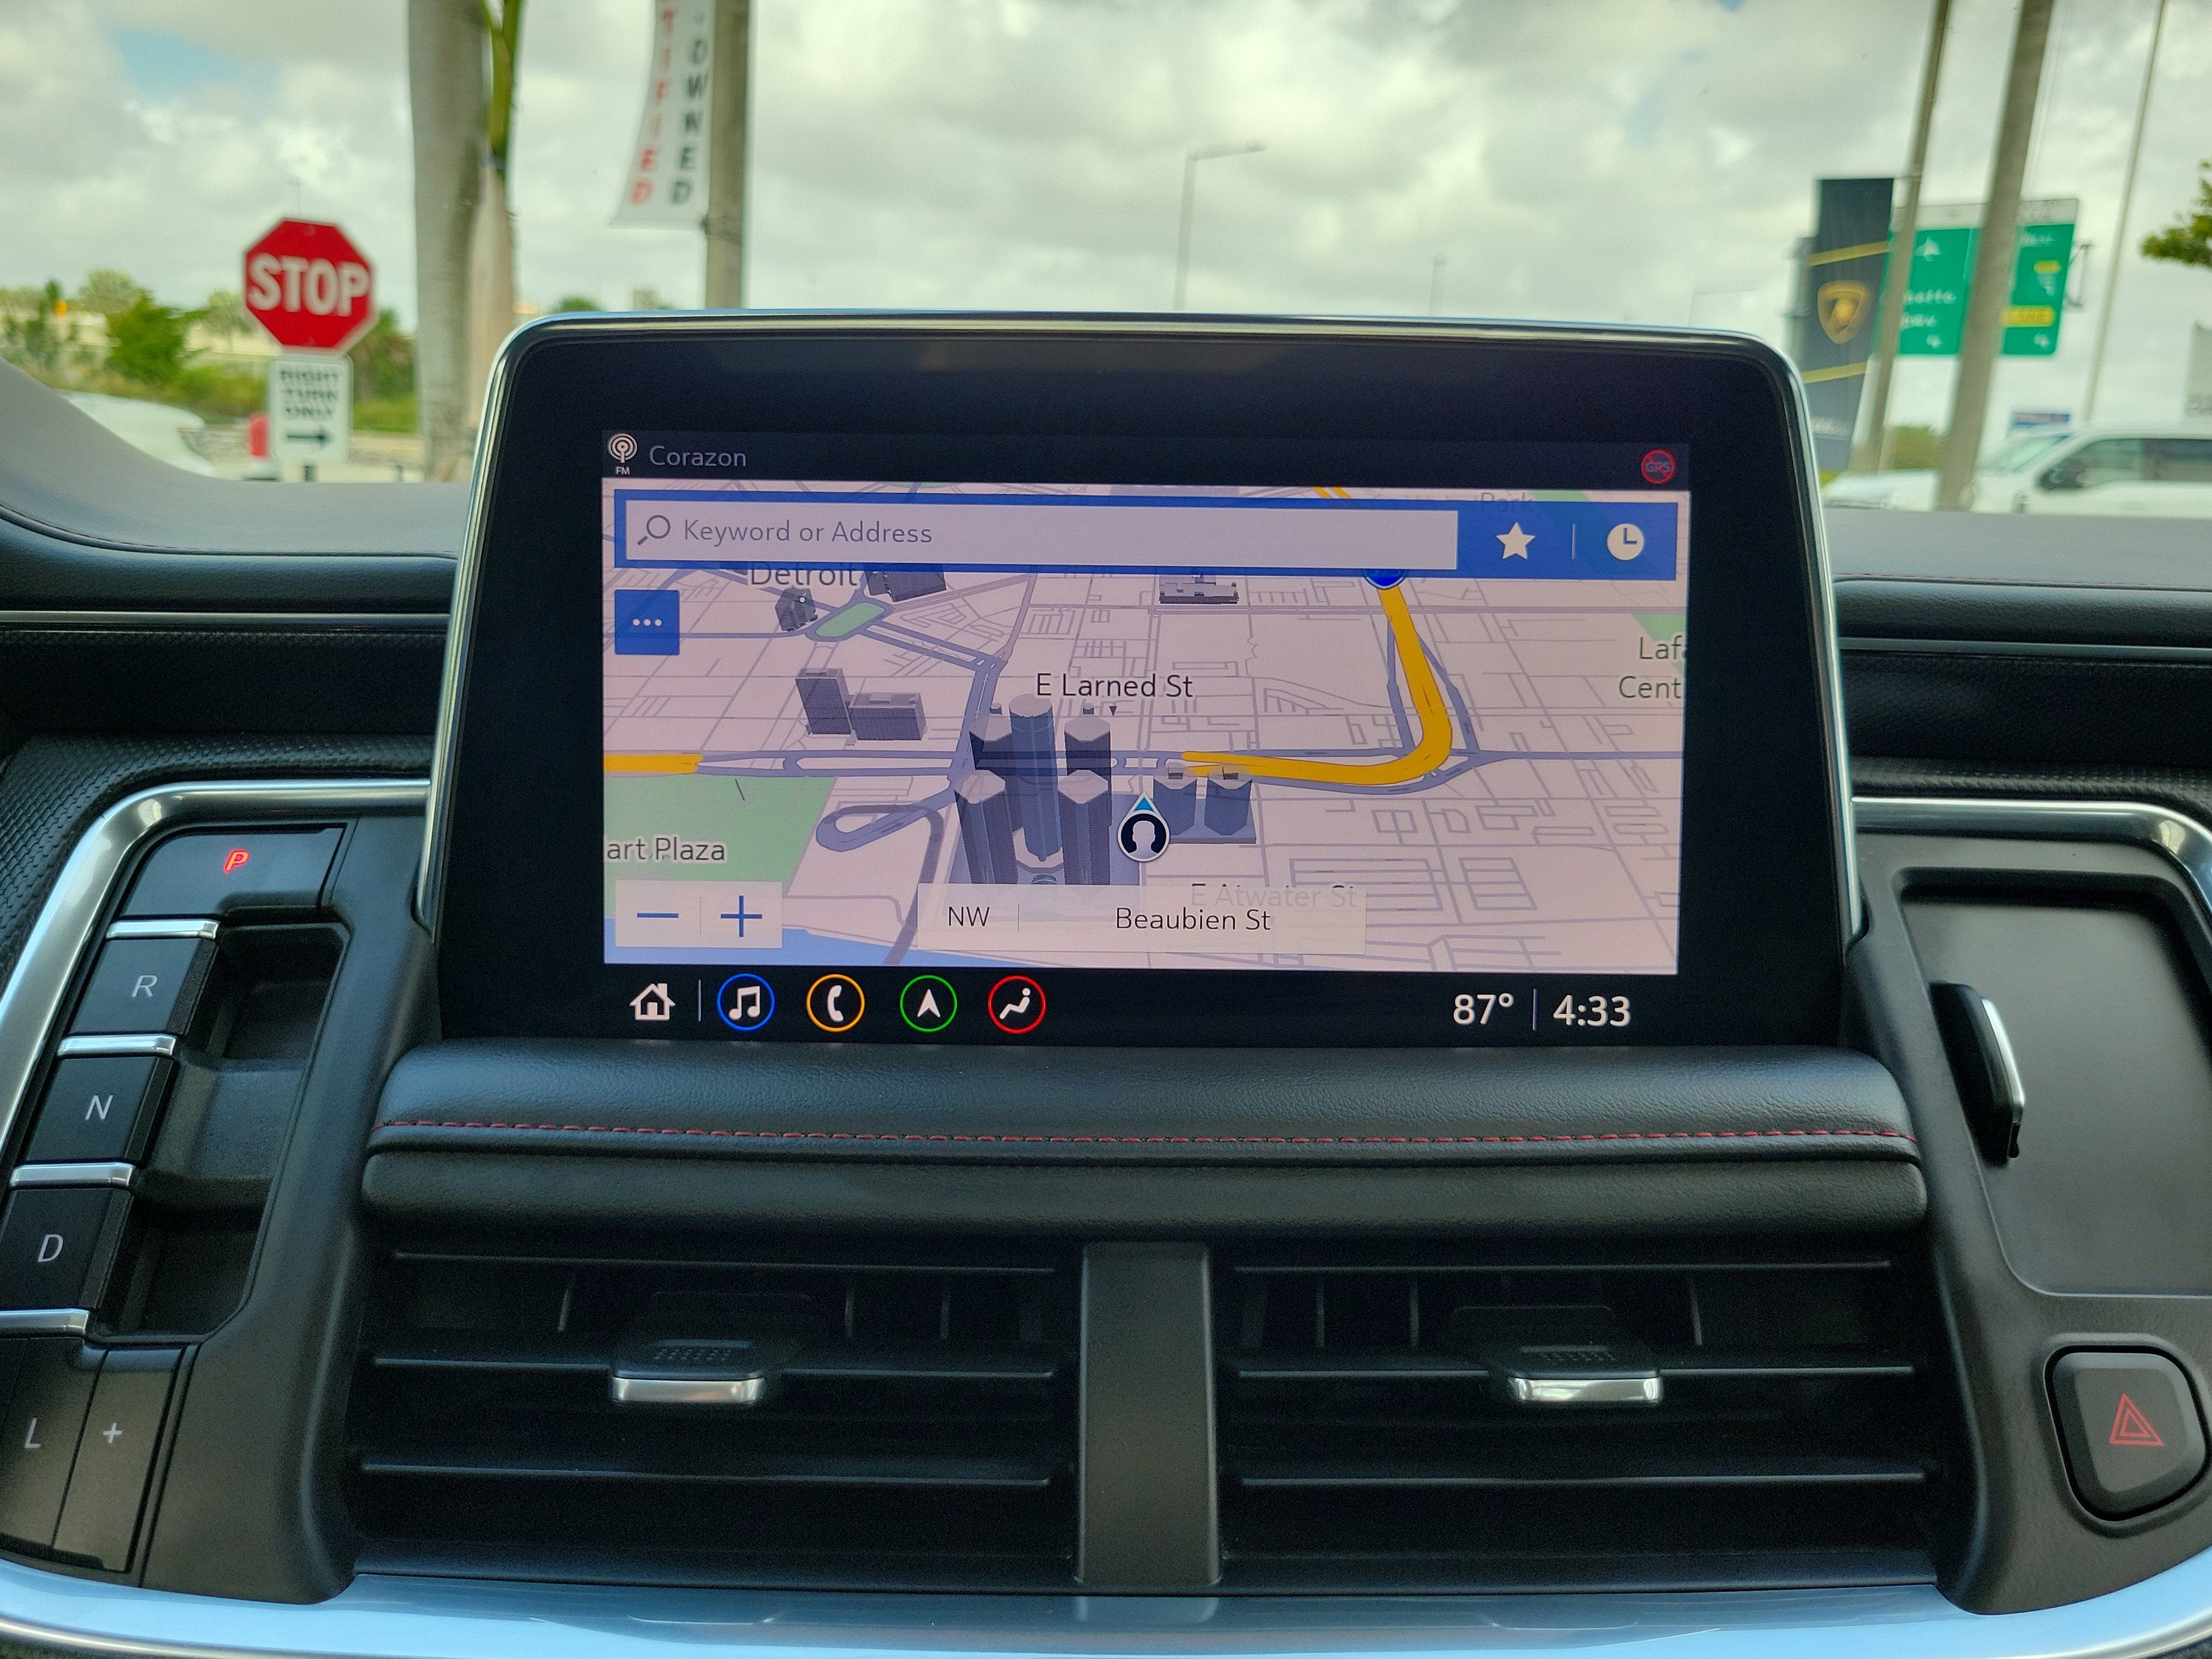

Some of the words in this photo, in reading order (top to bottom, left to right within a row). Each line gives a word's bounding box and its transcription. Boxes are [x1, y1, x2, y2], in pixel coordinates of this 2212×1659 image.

[246, 252, 372, 317] STOP
[649, 445, 747, 468] Corazon
[616, 467, 630, 475] FM
[684, 519, 790, 547] Keyword
[799, 525, 825, 541] or
[832, 521, 932, 544] Address
[751, 563, 858, 586] Detroit
[1036, 673, 1052, 696] E
[1062, 673, 1156, 697] Larned
[1166, 675, 1193, 698] St
[1619, 675, 1681, 698] Cent
[224, 849, 250, 873] P
[607, 838, 646, 861] art
[655, 837, 726, 861] Plaza
[1192, 883, 1206, 906] E
[1215, 883, 1322, 907] Atwater
[1330, 884, 1357, 907] St
[947, 906, 990, 927] NW
[1115, 907, 1237, 931] Beaubien
[1246, 909, 1271, 932] St
[132, 975, 157, 997] R
[1453, 992, 1515, 1025] 87°
[1553, 995, 1631, 1027] 4:33
[85, 1094, 113, 1120] N
[37, 1234, 64, 1262] D
[24, 1418, 41, 1449] L
